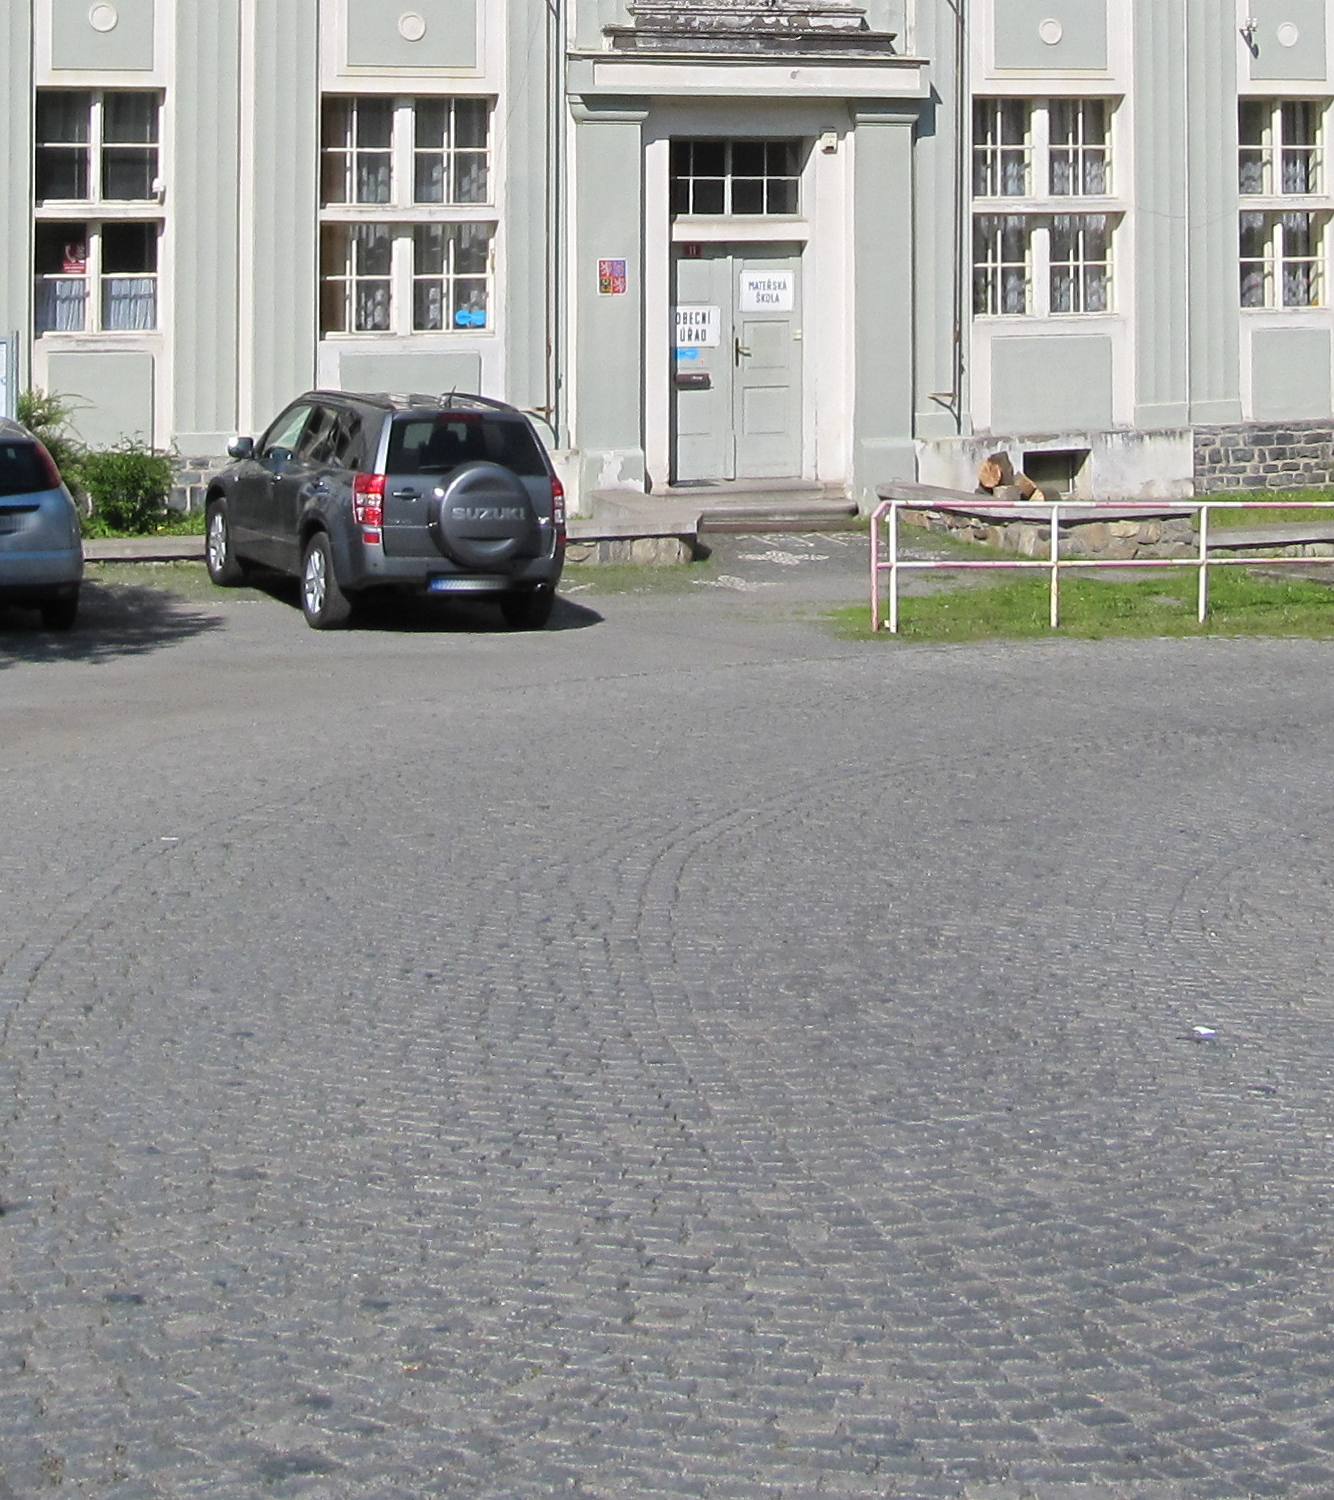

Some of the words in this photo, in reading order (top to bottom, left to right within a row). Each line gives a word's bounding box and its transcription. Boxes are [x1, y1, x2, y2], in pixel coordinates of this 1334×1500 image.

[748, 279, 788, 292] MATEŘSKÁ
[755, 292, 780, 304] ŠKOLA
[675, 309, 711, 325] OBECNÍ
[451, 506, 526, 521] SUZUKI
